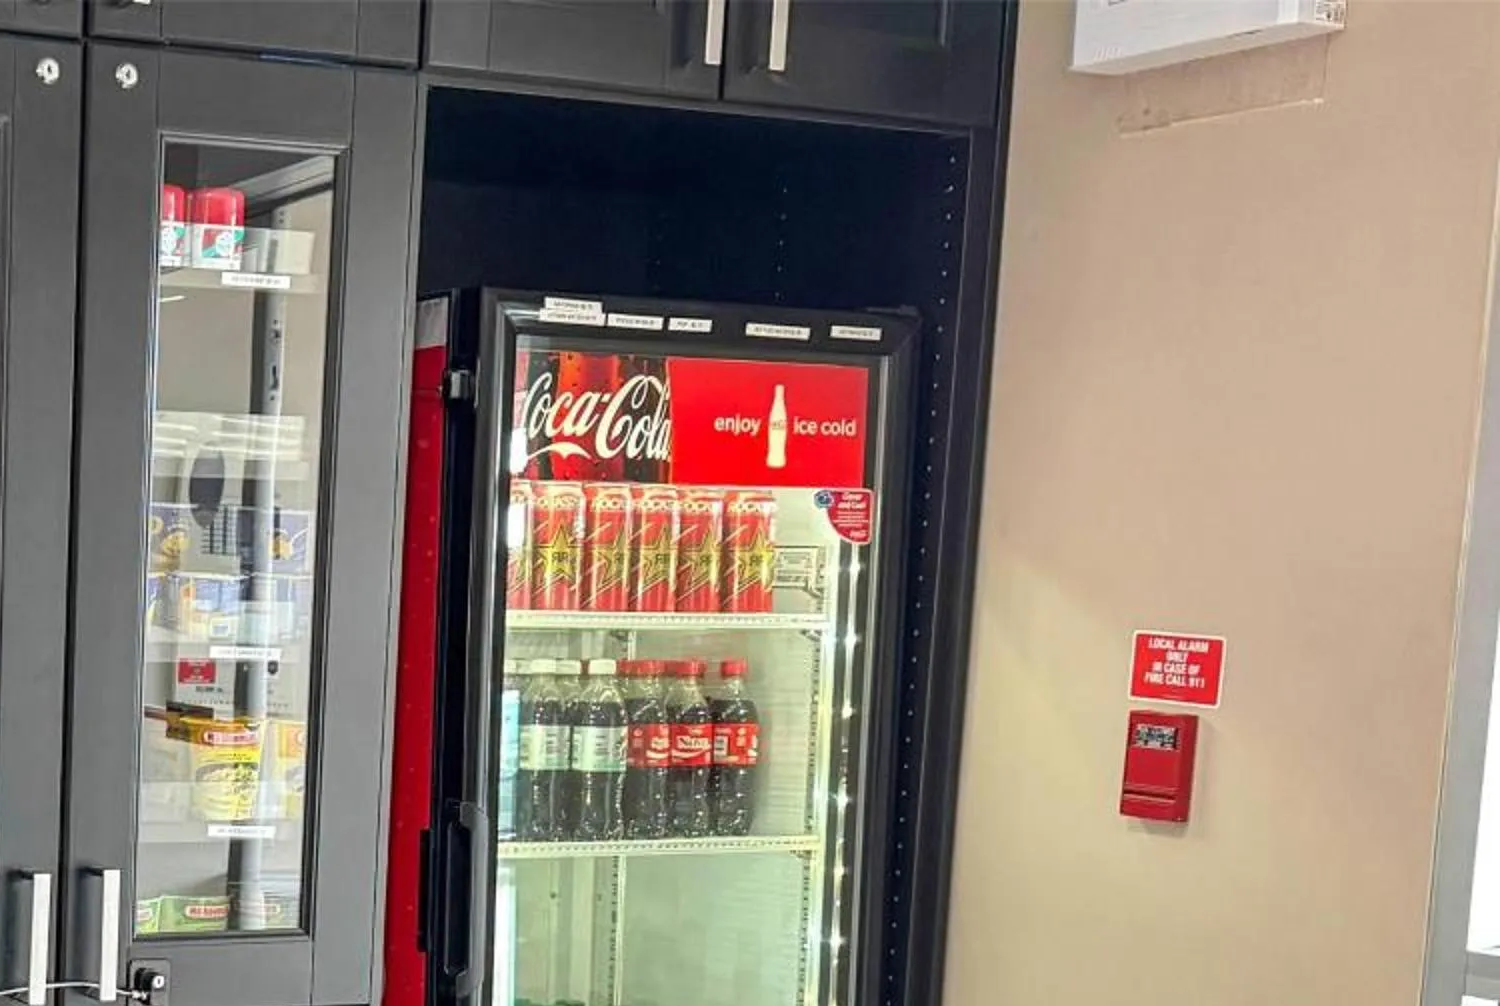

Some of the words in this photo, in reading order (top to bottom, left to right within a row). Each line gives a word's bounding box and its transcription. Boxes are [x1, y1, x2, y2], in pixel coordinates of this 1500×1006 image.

[521, 372, 671, 459] Coca-Cola
[714, 413, 761, 436] enjoy
[793, 416, 818, 435] ice
[820, 417, 857, 437] cold
[1148, 637, 1175, 650] LOCAL
[1177, 639, 1209, 653] ALARM
[1166, 650, 1189, 662] ONLY
[1163, 662, 1187, 674] CASE
[1187, 664, 1201, 675] OF
[1144, 671, 1164, 684] FIRE
[1165, 673, 1187, 687] CALL
